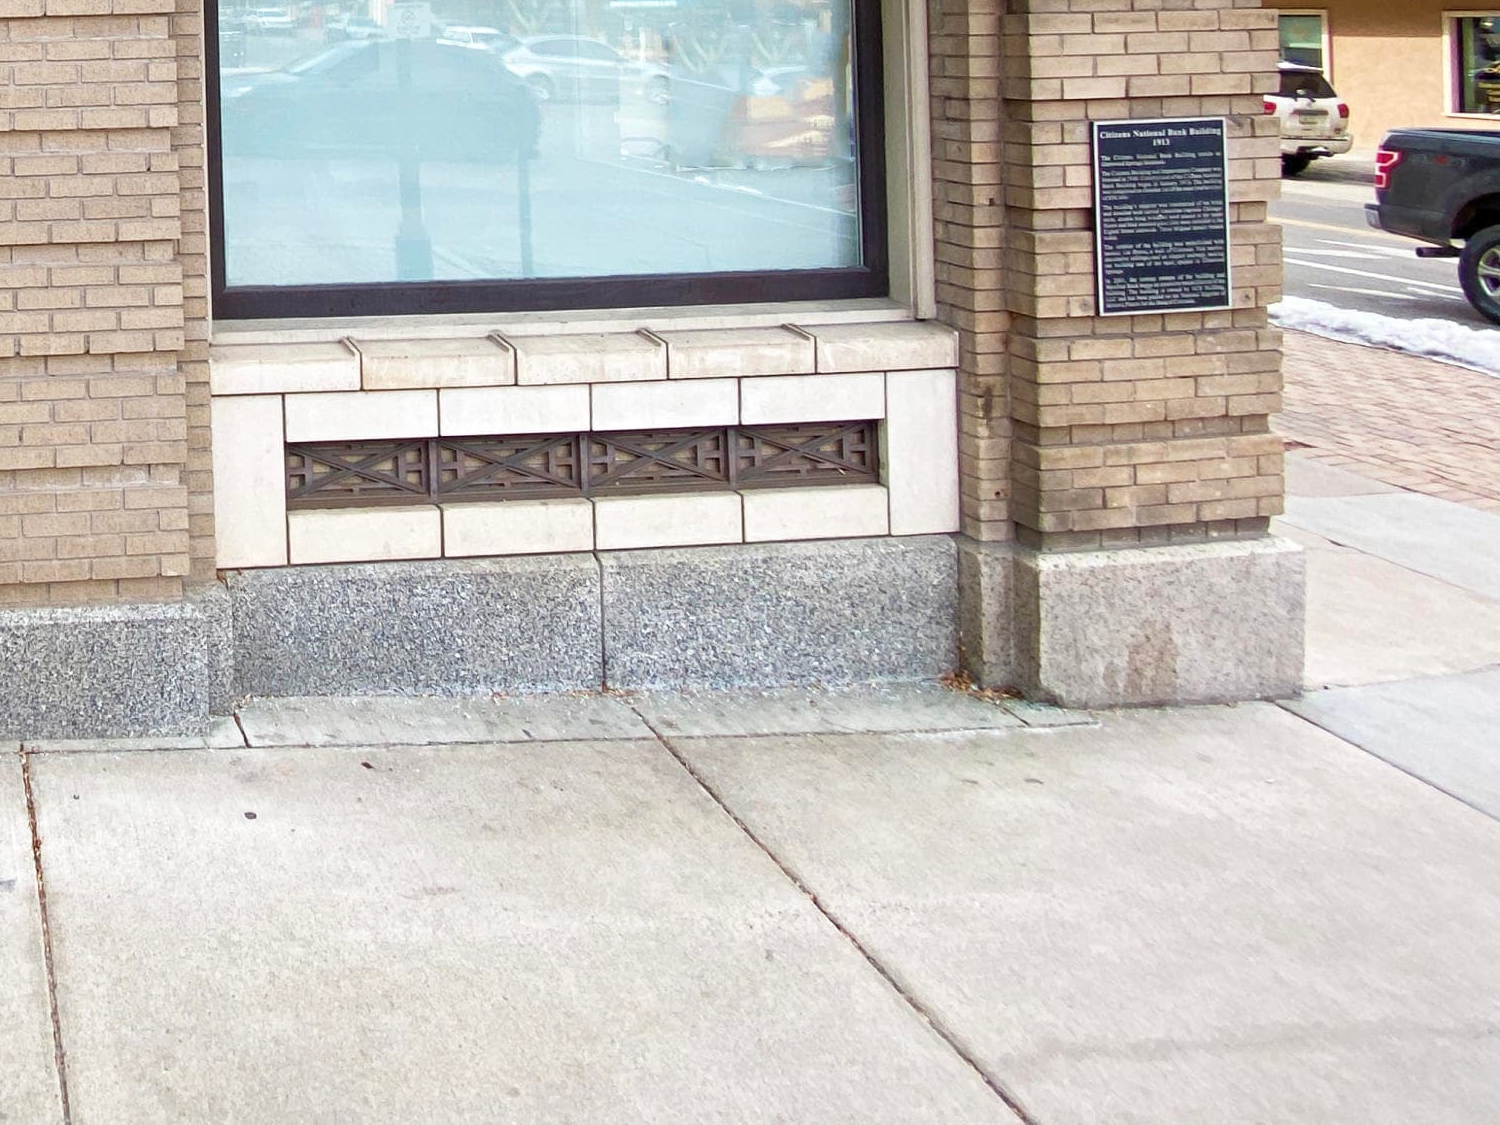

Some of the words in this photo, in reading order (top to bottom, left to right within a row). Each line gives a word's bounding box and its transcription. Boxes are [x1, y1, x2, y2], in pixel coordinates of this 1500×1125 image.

[1132, 129, 1166, 138] National
[1167, 128, 1187, 137] Bank
[1189, 127, 1222, 136] Building
